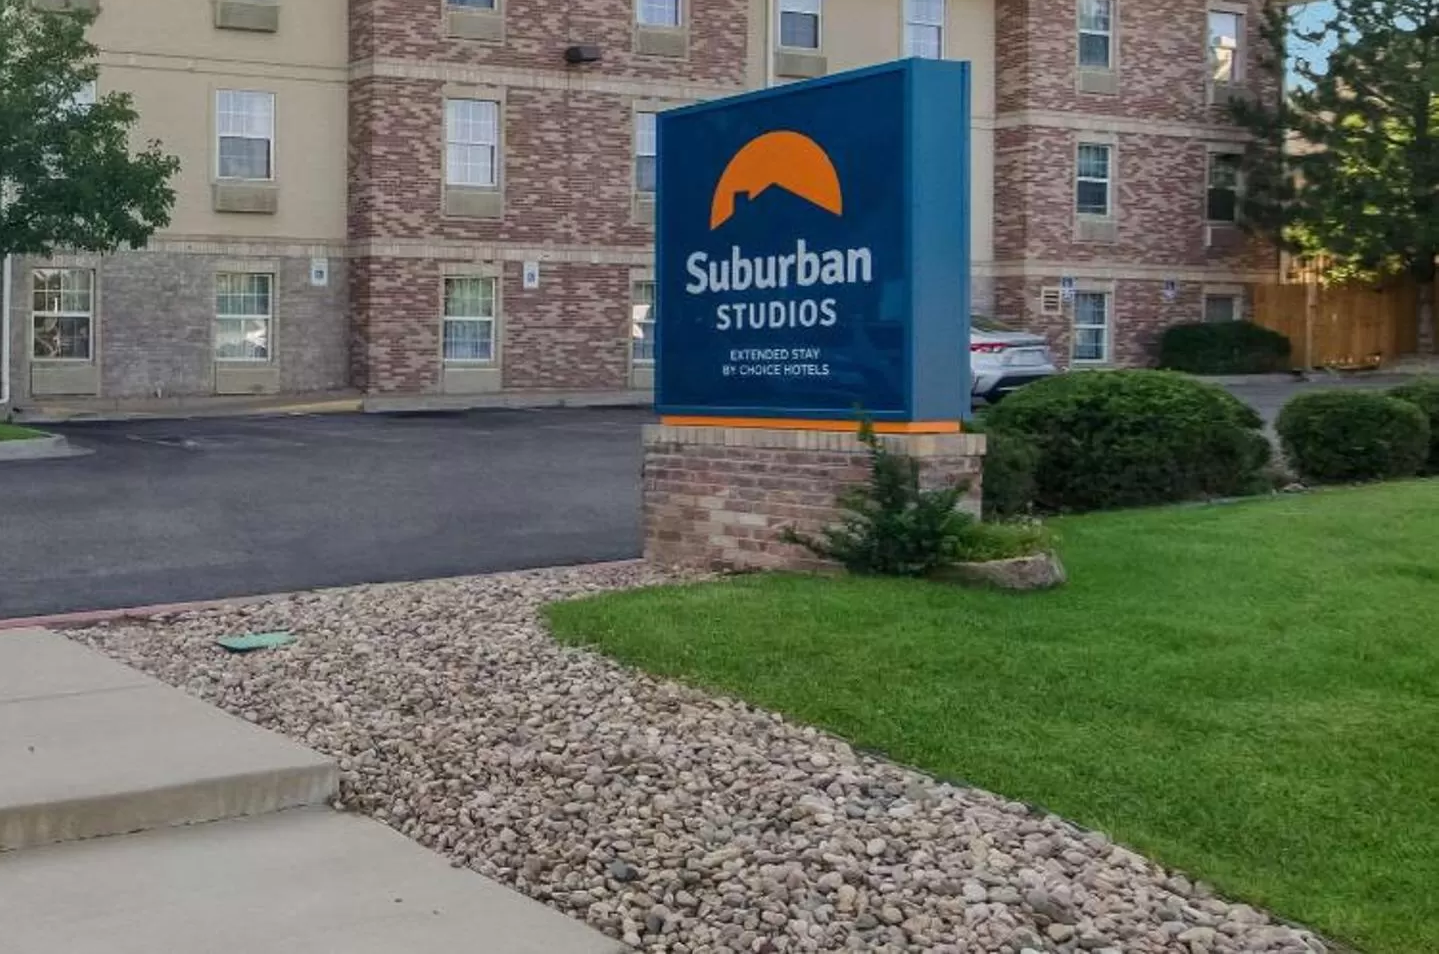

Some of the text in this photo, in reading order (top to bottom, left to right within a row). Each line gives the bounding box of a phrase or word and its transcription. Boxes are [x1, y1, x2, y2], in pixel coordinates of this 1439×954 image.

[685, 239, 873, 295] Suburban
[716, 298, 838, 331] STUDIOS
[730, 348, 821, 361] EXTENDED STAY
[722, 364, 830, 376] BY CHOICE HOTELS
